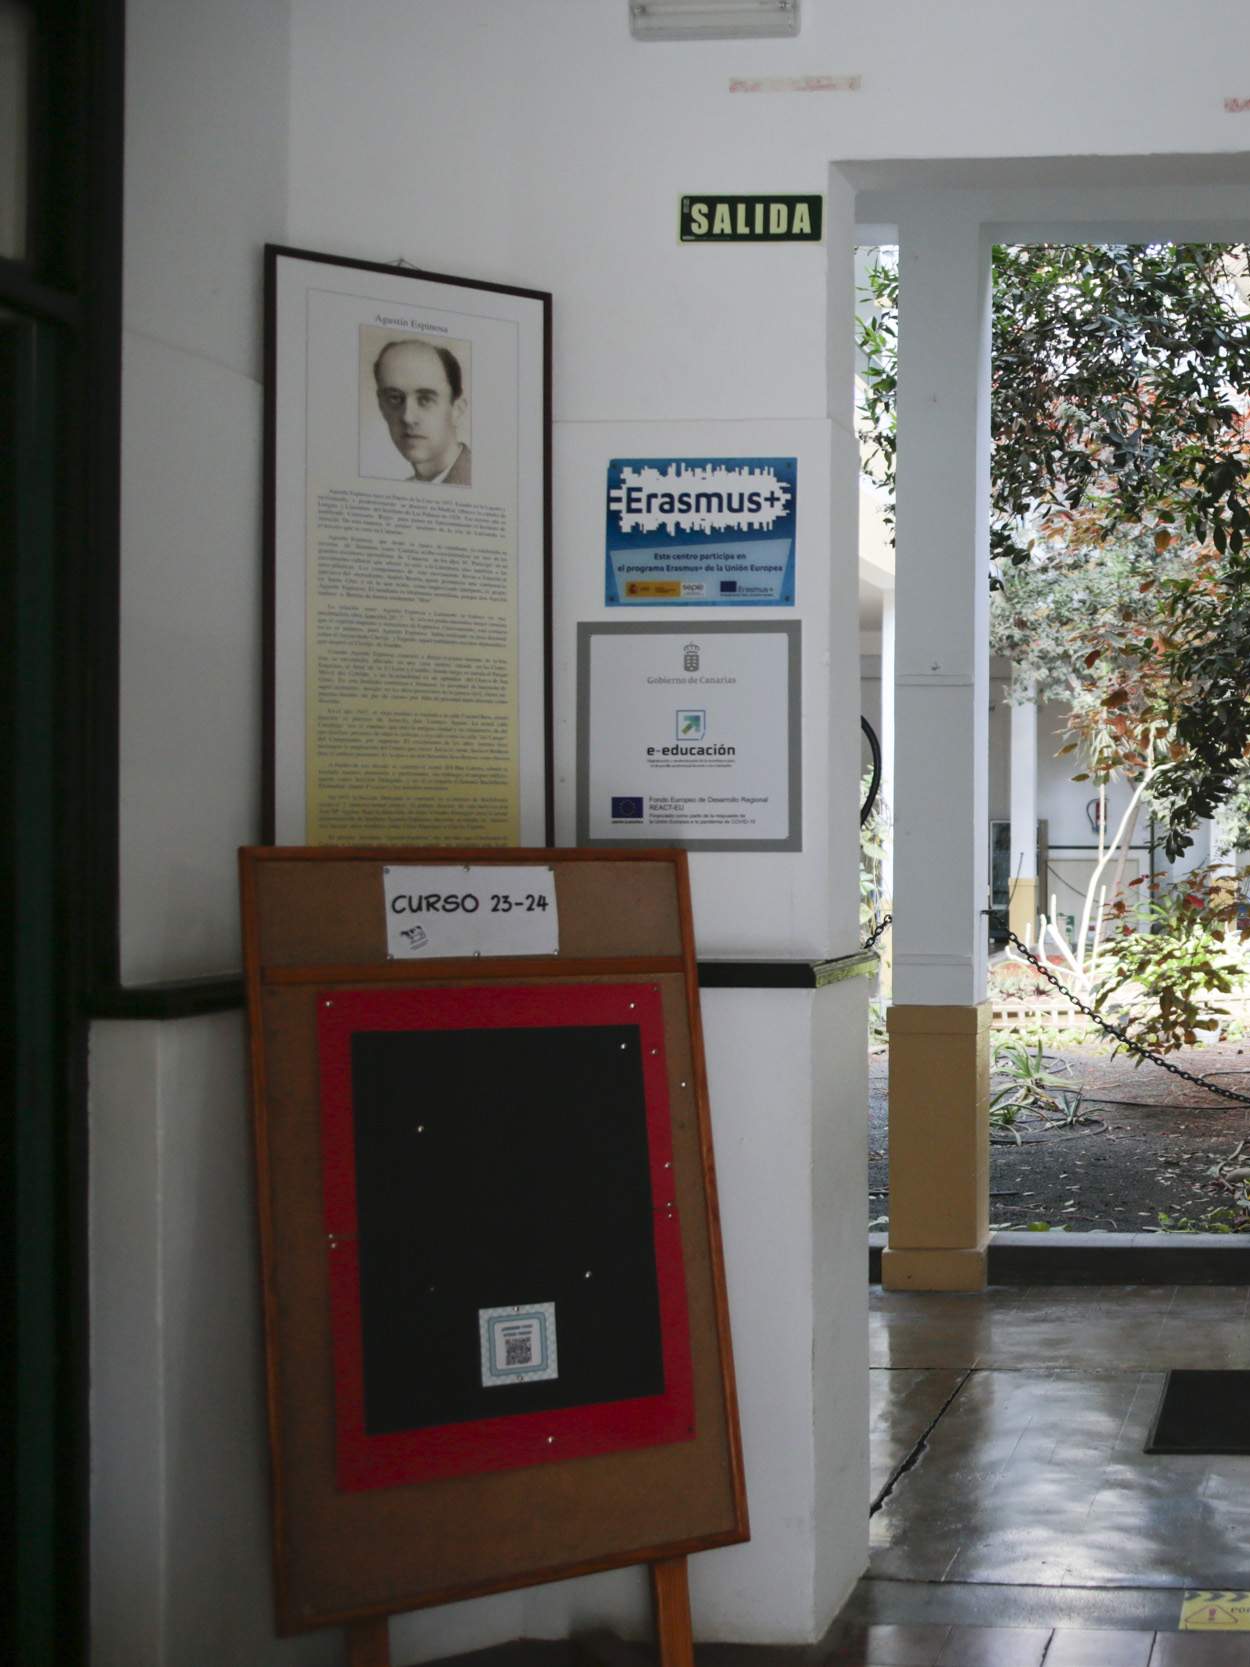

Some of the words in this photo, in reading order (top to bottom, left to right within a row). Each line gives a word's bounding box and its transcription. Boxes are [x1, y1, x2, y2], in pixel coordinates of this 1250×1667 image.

[690, 202, 812, 235] SALIDA
[410, 319, 448, 332] Espinosa
[626, 487, 780, 514] Erasmus+
[672, 553, 697, 561] centro
[699, 552, 735, 562] participa
[617, 564, 625, 572] el
[626, 565, 665, 573] programa
[705, 564, 714, 572] de
[716, 564, 724, 572] la
[725, 563, 748, 572] Unión
[750, 564, 783, 573] Europea
[646, 676, 687, 685] Gobierno
[689, 676, 698, 685] de
[699, 676, 736, 685] Canarias
[646, 743, 736, 756] e-educación
[649, 796, 669, 804] Fondo
[670, 796, 697, 805] Europeo
[698, 796, 706, 804] de
[741, 796, 769, 805] Regional
[391, 893, 479, 914] CURSO
[490, 894, 549, 912] 23-24
